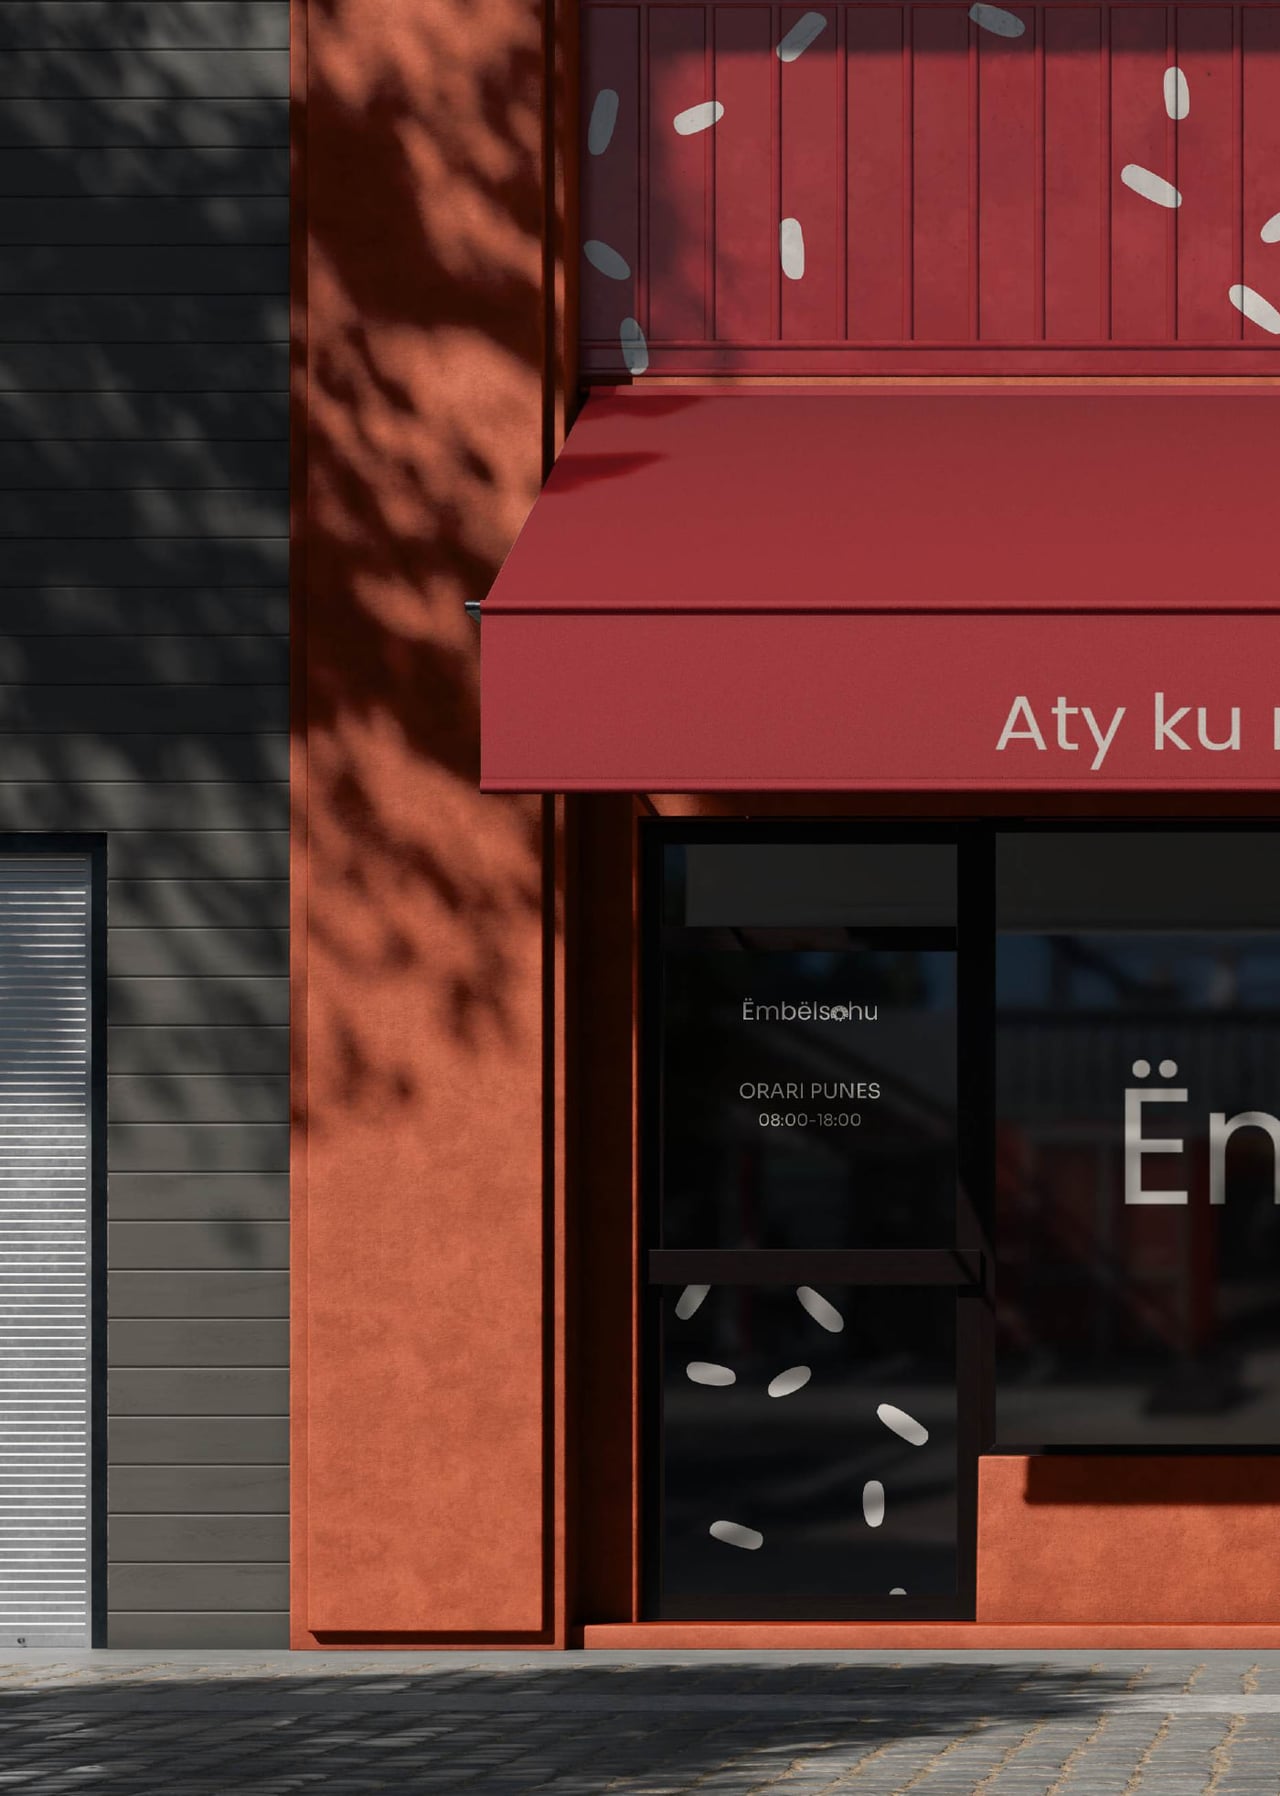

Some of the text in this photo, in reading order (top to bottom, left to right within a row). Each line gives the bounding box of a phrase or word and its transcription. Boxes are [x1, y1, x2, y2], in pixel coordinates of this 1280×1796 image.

[995, 695, 1126, 771] Aty
[1154, 691, 1241, 751] ku
[739, 1082, 881, 1100] ORARI PUNES
[758, 1112, 862, 1127] 08:00-18:00
